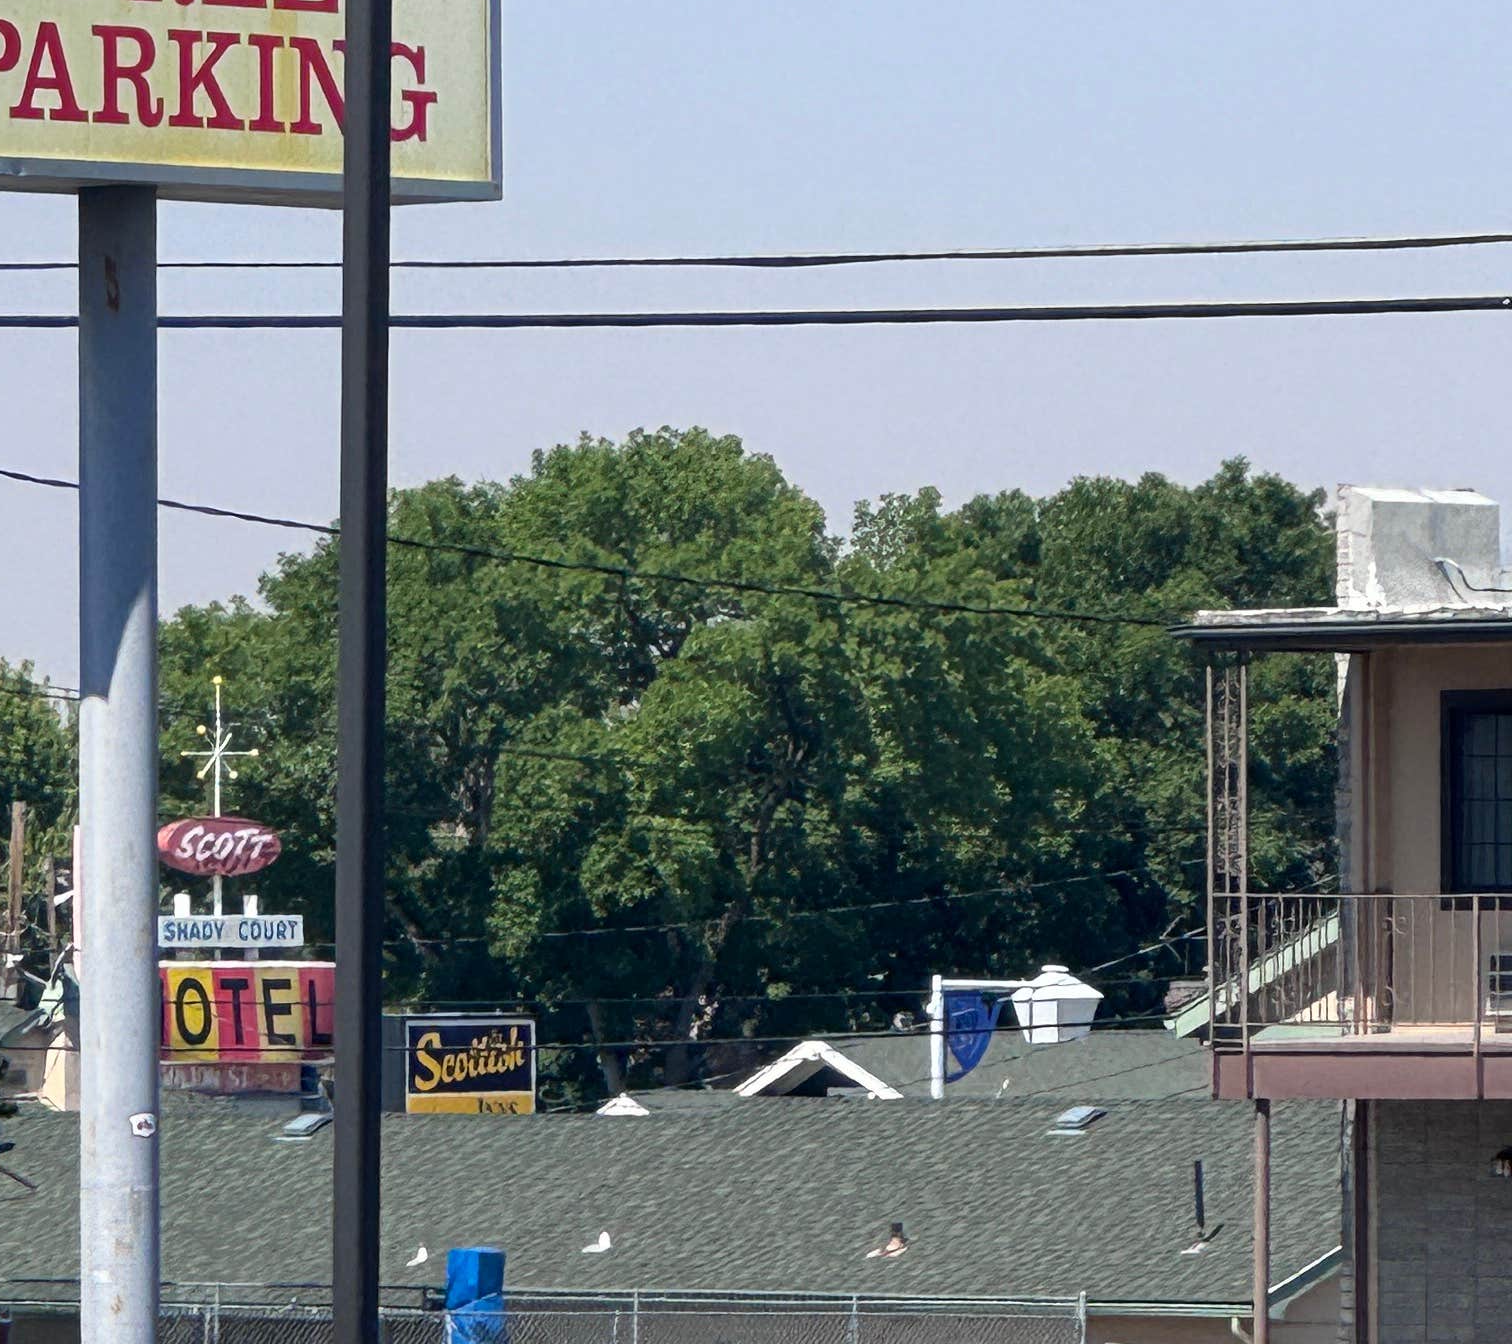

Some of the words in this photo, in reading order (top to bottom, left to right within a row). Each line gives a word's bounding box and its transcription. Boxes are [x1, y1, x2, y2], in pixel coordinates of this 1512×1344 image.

[176, 825, 273, 862] SCOTT
[164, 920, 225, 942] SHADY
[238, 920, 298, 941] COURT
[161, 978, 334, 1046] OTEL
